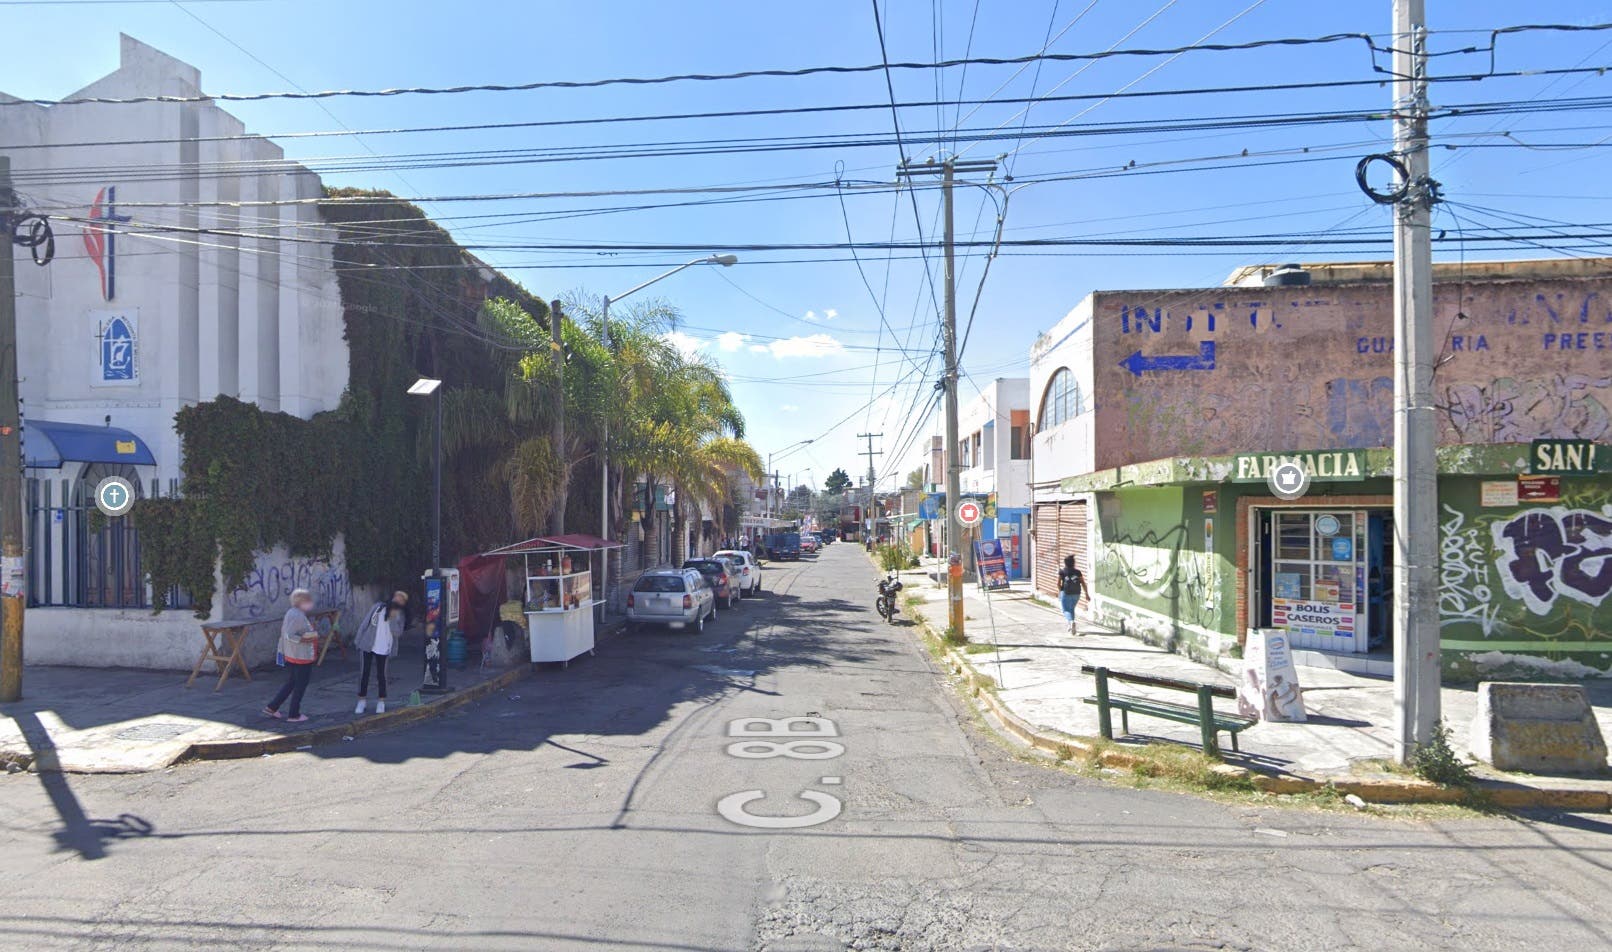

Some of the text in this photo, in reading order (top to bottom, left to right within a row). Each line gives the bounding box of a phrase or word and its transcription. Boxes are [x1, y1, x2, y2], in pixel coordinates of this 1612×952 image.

[1543, 332, 1612, 351] PREE
[1237, 452, 1360, 479] FARMACIA
[1296, 604, 1331, 614] BOLIS
[1287, 613, 1341, 625] CASEROS
